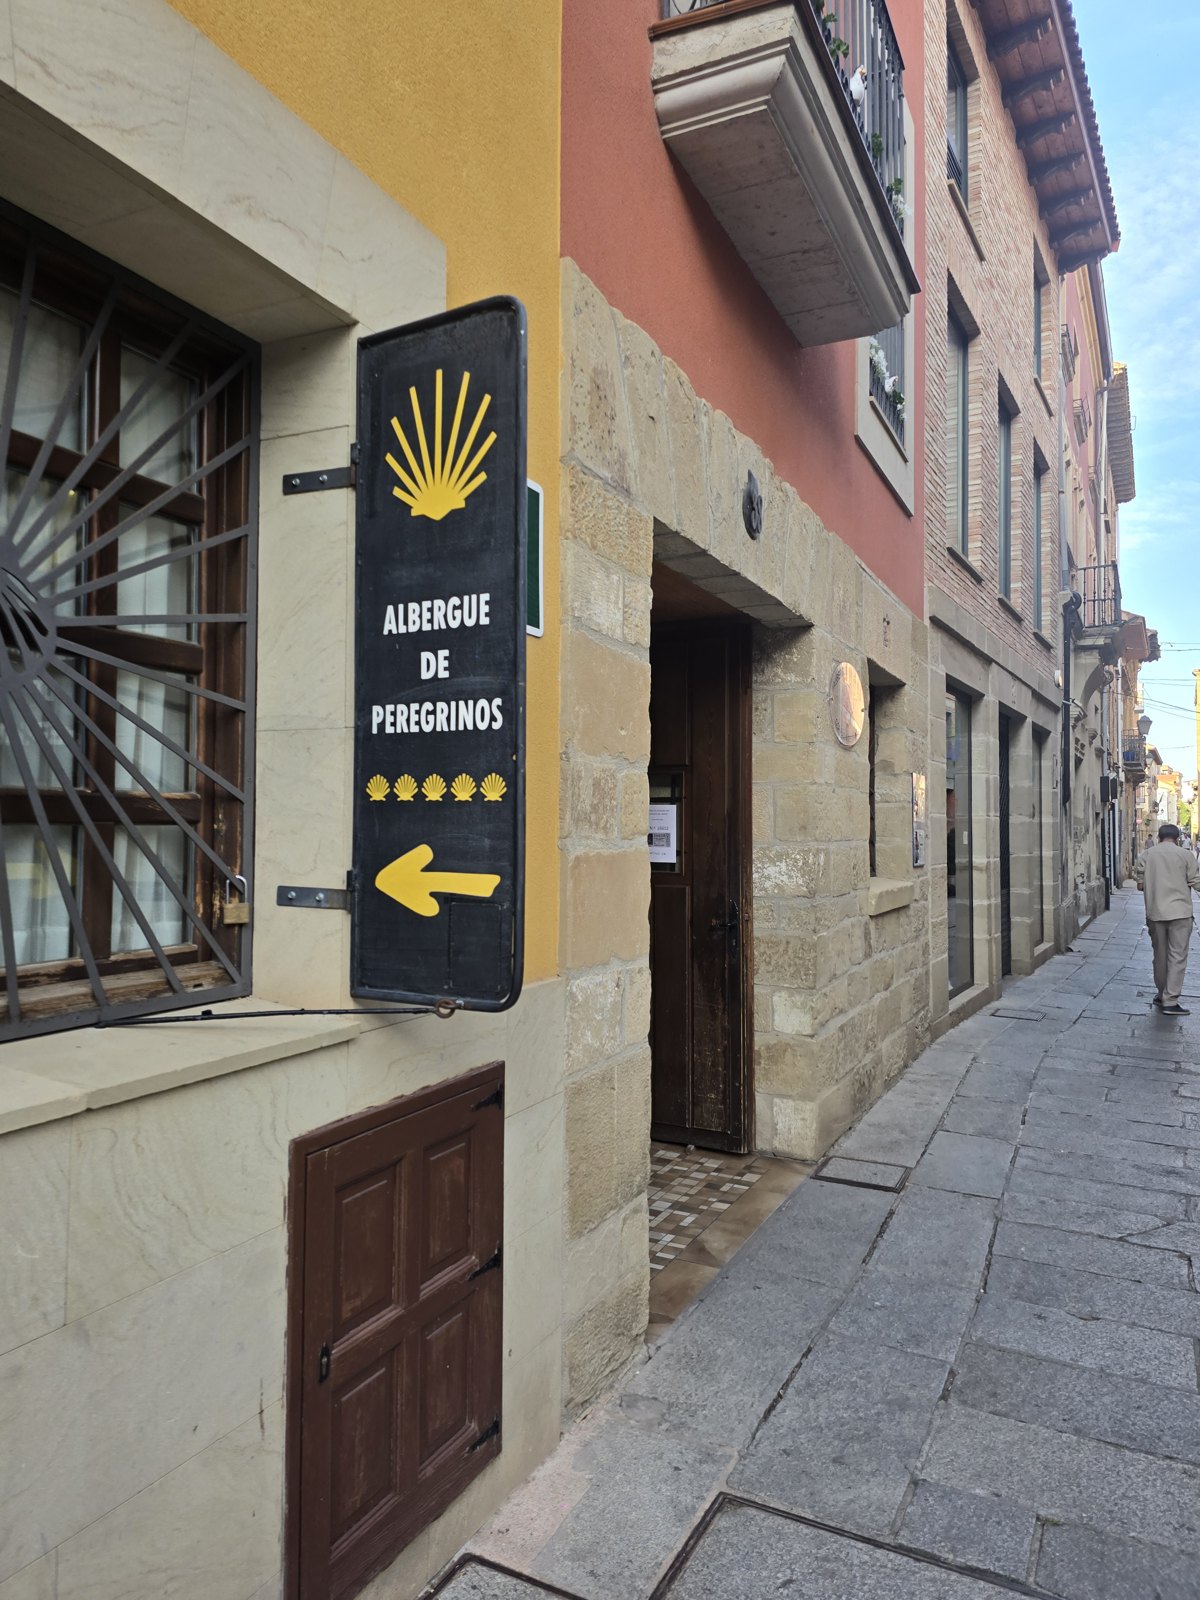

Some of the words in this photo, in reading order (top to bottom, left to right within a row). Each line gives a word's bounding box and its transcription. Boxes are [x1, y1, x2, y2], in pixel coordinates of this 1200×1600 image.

[383, 593, 491, 635] ALBERGUE
[420, 649, 450, 680] DE
[372, 698, 503, 734] PEREGRINOS
